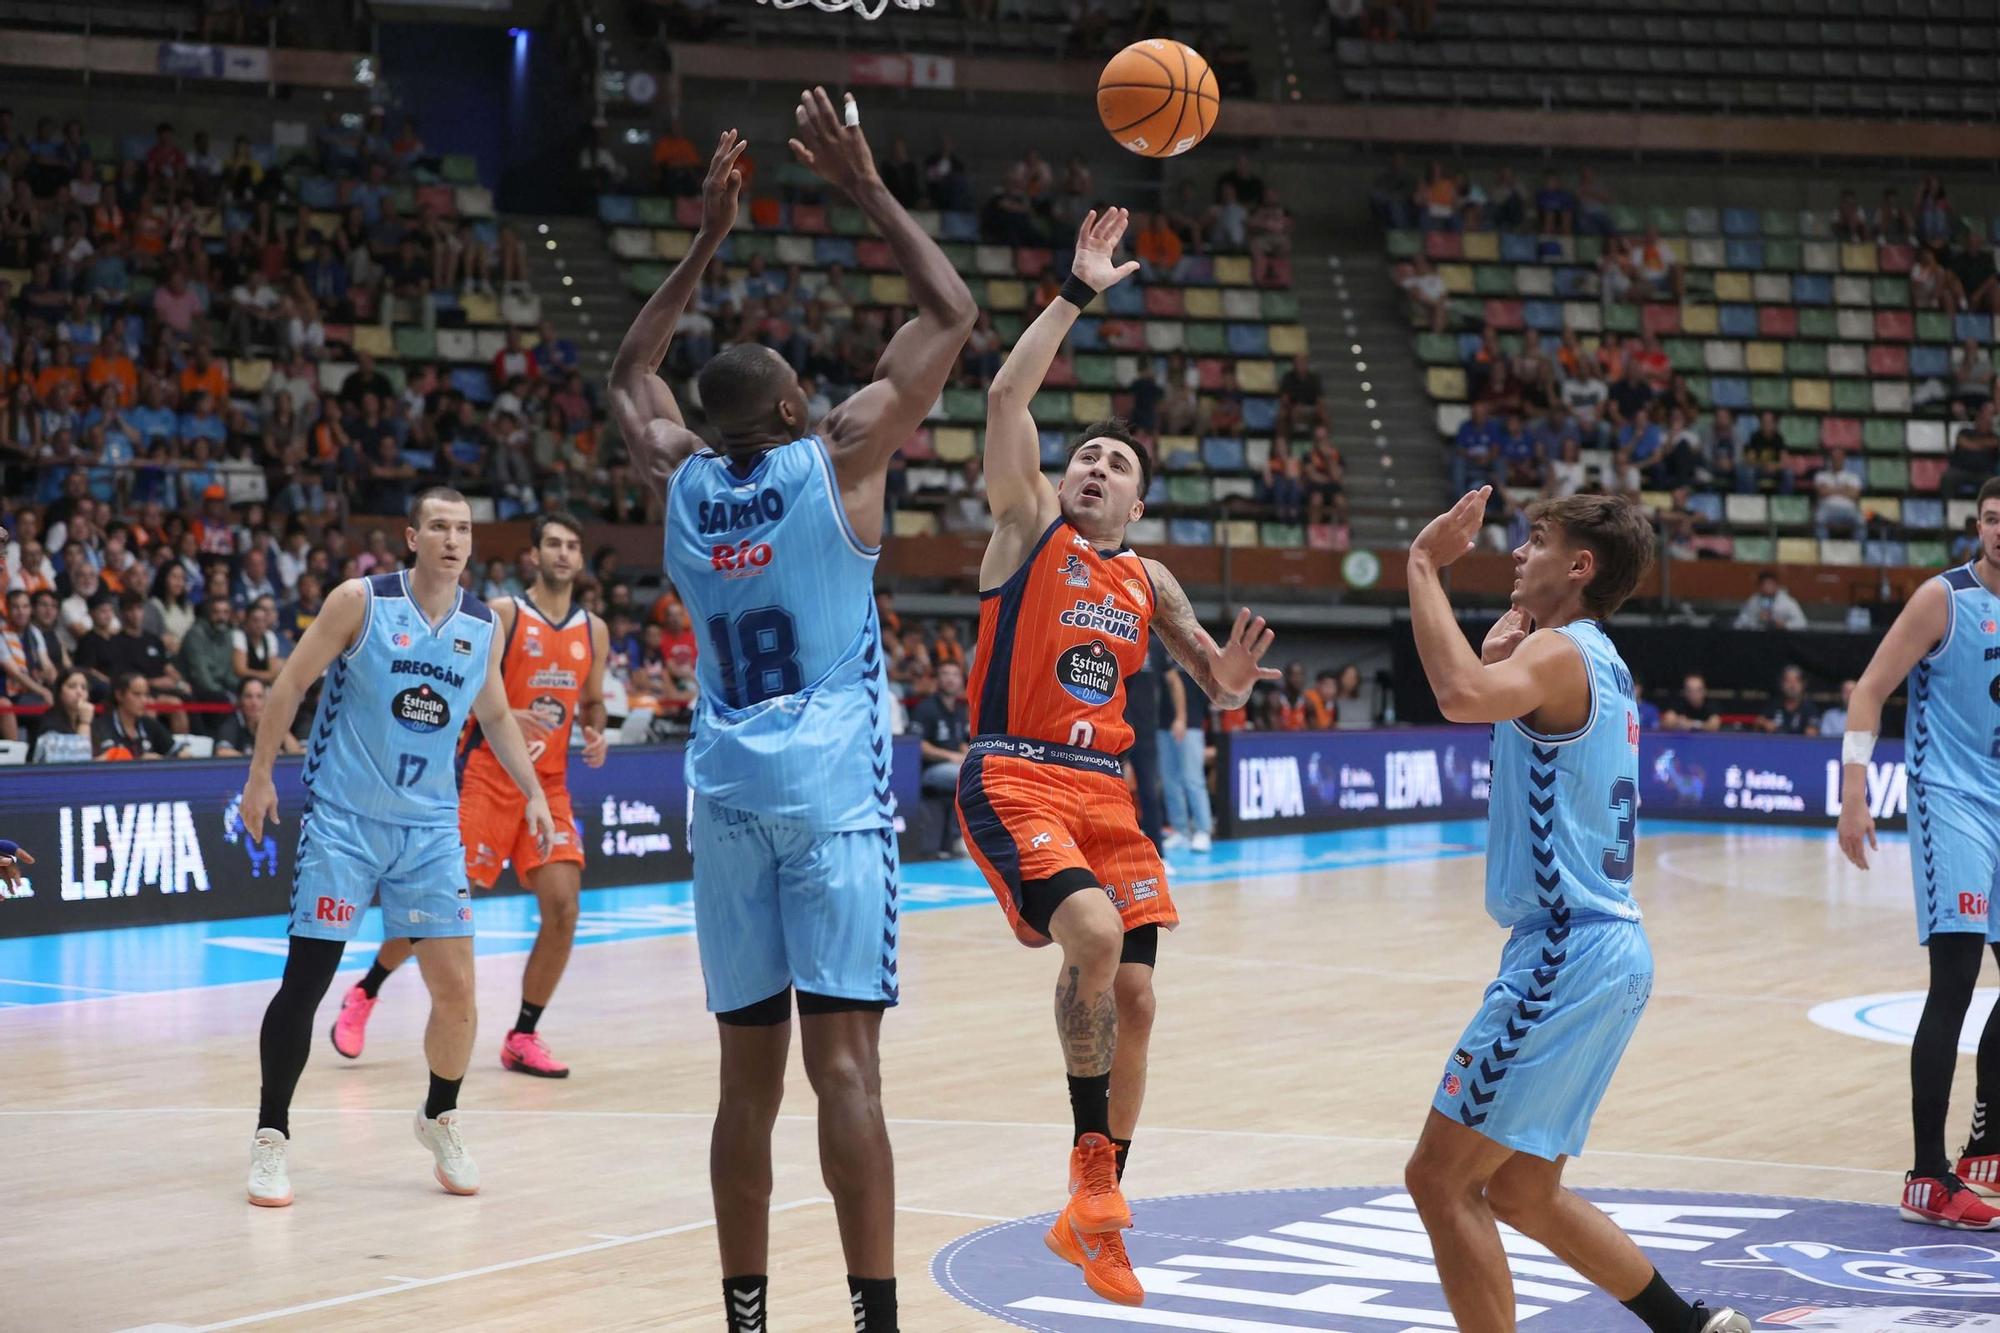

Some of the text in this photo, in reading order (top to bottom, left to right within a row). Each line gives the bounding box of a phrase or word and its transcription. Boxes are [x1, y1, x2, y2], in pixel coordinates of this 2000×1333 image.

[707, 605, 807, 709] 18
[1070, 653, 1114, 678] Estrella
[390, 659, 465, 690] BREOGÁN
[1070, 668, 1109, 692] Galicia
[401, 705, 439, 724] Galicia
[403, 694, 443, 713] Estrella
[395, 753, 429, 788] 17
[1238, 756, 1305, 820] LEYMA
[1601, 777, 1638, 883] 3
[60, 801, 210, 901] LEYMA
